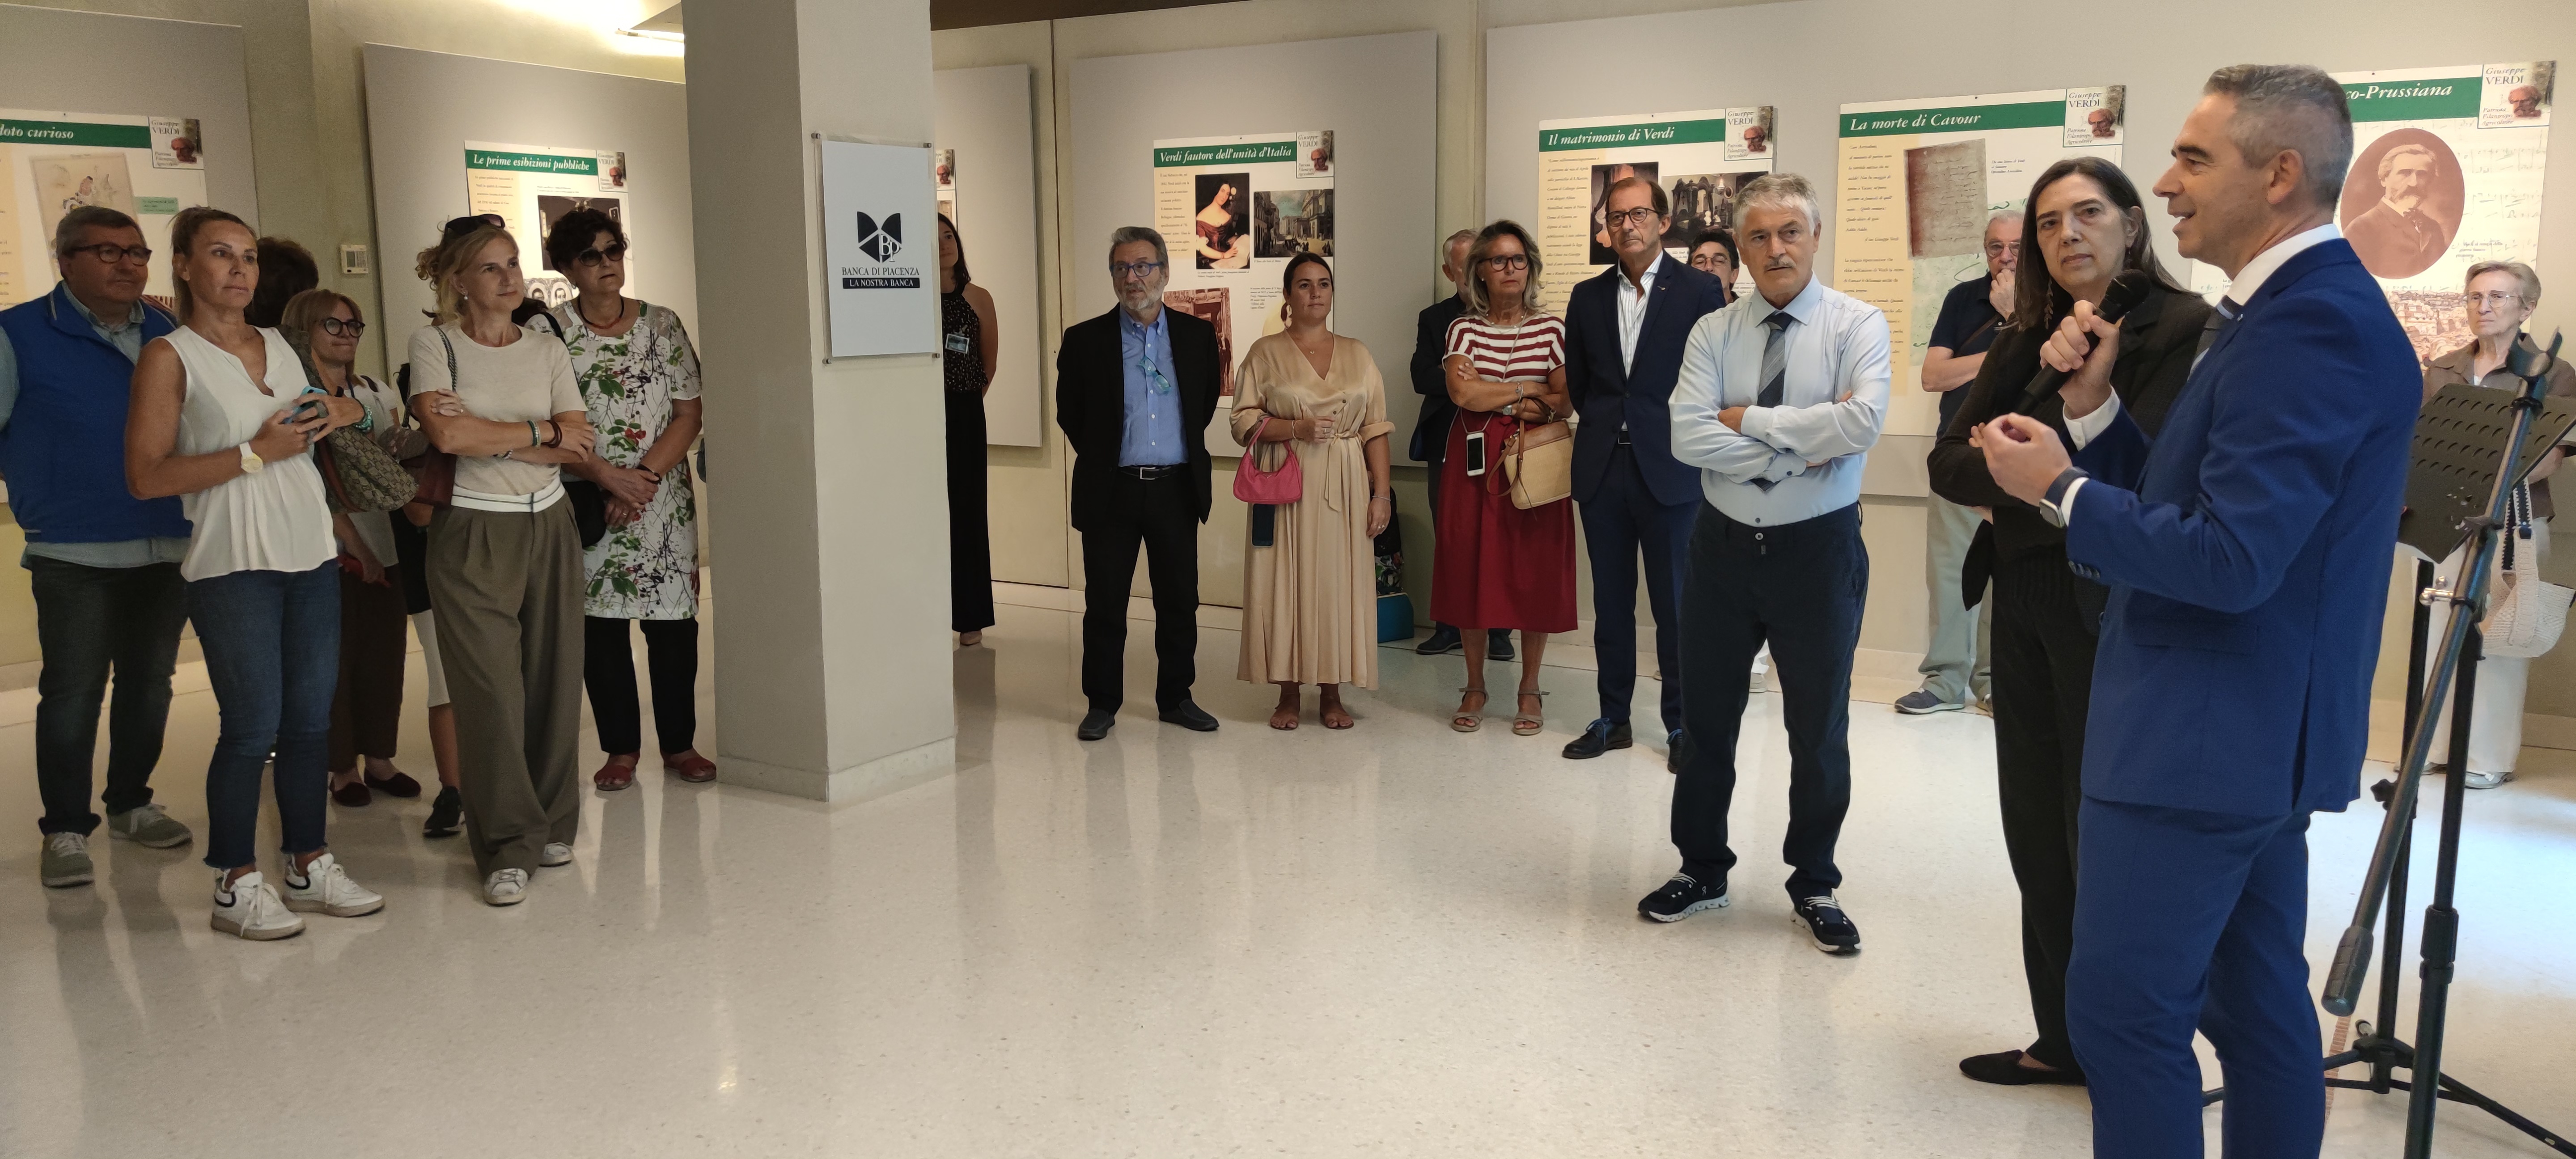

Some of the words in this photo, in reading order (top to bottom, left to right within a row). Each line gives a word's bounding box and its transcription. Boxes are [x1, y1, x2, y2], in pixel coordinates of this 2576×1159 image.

[2486, 75, 2524, 85] VERDI
[2069, 99, 2100, 108] VERDI
[1728, 117, 1753, 125] VERDI
[1850, 118, 1868, 131] La
[1872, 118, 1908, 129] morte
[1912, 114, 1927, 127] di
[1931, 114, 1981, 126] Cavour
[27, 126, 74, 139] curioso
[153, 127, 179, 135] VERDI
[1548, 134, 1558, 145] Il
[1560, 130, 1625, 144] matrimonio
[1628, 129, 1641, 140] di
[1644, 127, 1675, 140] Verdi
[1160, 150, 1182, 162] Verdi
[1182, 150, 1213, 164] fautore
[1216, 148, 1256, 160] dell'unità
[1259, 146, 1291, 157] d'Italia
[474, 154, 484, 164] Le
[486, 155, 511, 167] prime
[513, 157, 551, 168] esibizioni
[553, 159, 589, 171] pubbliche
[842, 267, 869, 275] BANCA
[872, 267, 880, 275] DI
[883, 267, 919, 275] PIACENZA
